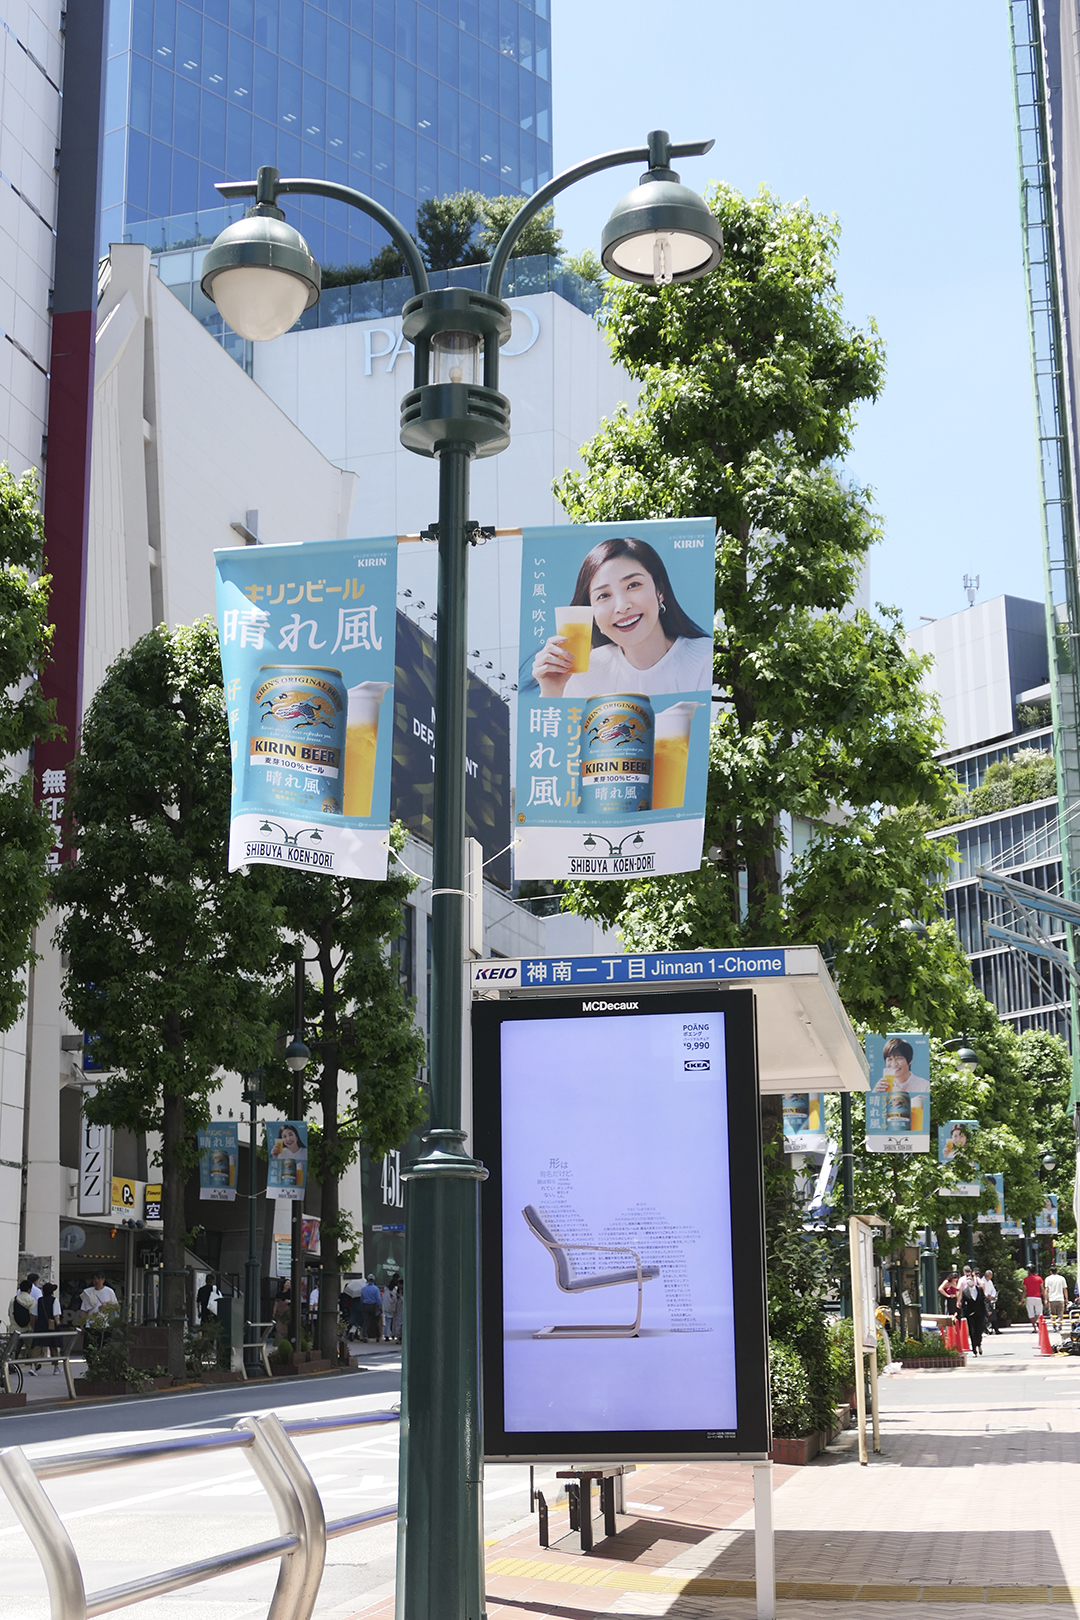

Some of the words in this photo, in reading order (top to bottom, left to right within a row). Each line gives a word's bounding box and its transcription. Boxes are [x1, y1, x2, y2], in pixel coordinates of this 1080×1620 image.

[363, 306, 540, 376] PAO
[674, 539, 705, 549] KIRIN
[357, 557, 387, 568] KIRIN
[244, 578, 366, 605] キリンビール
[532, 557, 547, 645] いい風、吹け。
[223, 604, 383, 655] 晴れ風
[281, 676, 327, 690] ORIGINAL
[255, 740, 297, 757] KIRIN
[301, 745, 335, 763] BEER
[526, 706, 562, 808] 晴れ風
[564, 706, 582, 808] キリンビール
[264, 756, 325, 775] 麦芽100%ビール
[585, 761, 618, 774] KIRIN
[622, 760, 648, 771] BEER
[266, 770, 321, 795] 晴れ風
[595, 786, 637, 800] 晴れ風
[246, 843, 282, 858] SHIBUYA
[287, 847, 333, 867] KOEN-DORI
[570, 859, 608, 873] SHIBUYA
[613, 855, 654, 872] KOEN-DORI
[475, 967, 517, 980] KEIO
[526, 958, 646, 983] 神南一丁目
[651, 960, 703, 976] Jinnan
[708, 956, 782, 974] 1-Chome
[582, 1001, 639, 1012] MCDecaux
[869, 1096, 880, 1129] 晴れ風
[200, 1136, 237, 1148] 晴れ風
[549, 1158, 569, 1169] 形は
[146, 1203, 161, 1219] 空
